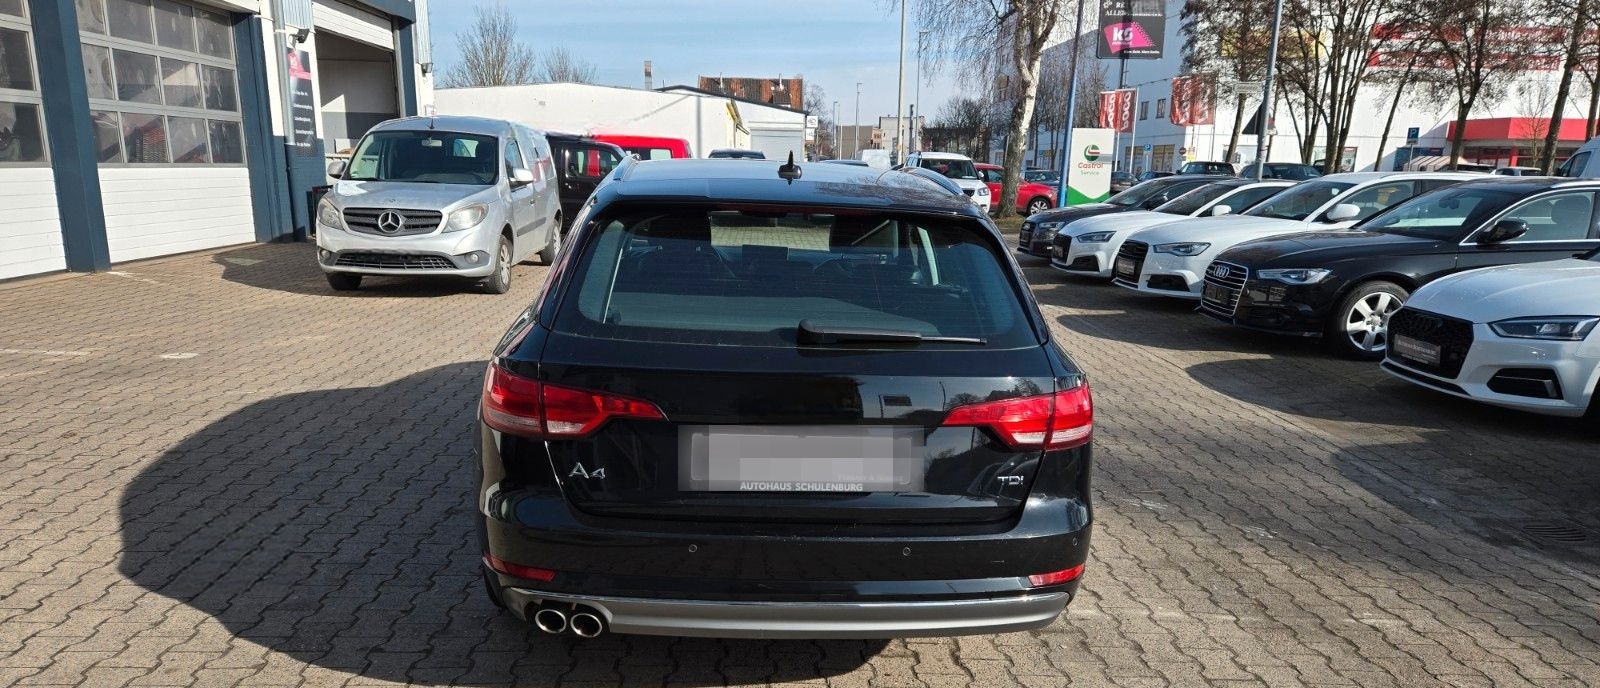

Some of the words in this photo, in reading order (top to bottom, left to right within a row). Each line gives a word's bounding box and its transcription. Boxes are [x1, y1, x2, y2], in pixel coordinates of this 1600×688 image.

[569, 462, 606, 479] A4
[997, 475, 1024, 486] TDI
[740, 481, 791, 491] AUTOHAUS
[795, 482, 863, 492] SCHULENBURG
